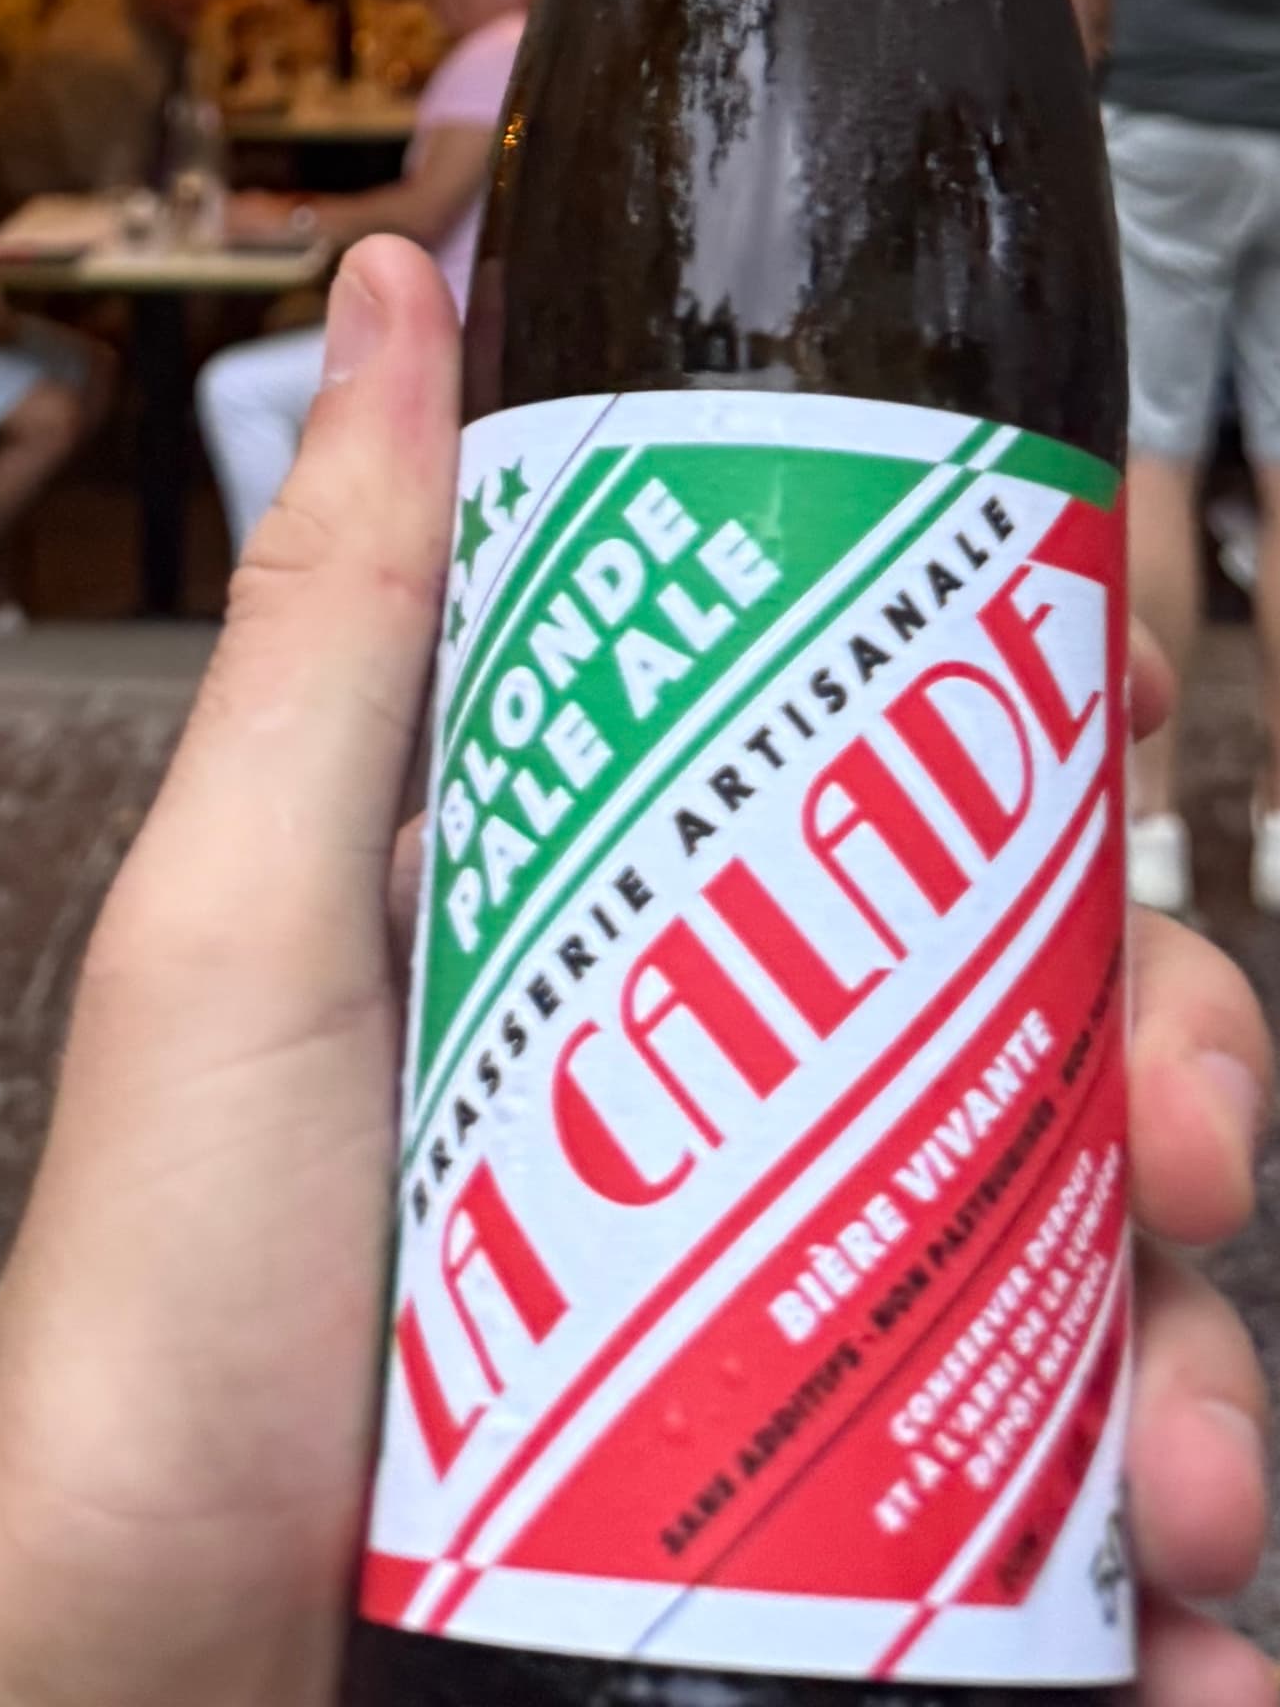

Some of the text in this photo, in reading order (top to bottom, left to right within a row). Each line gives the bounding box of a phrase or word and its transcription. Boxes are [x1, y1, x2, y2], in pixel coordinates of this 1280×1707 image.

[411, 496, 1015, 1226] BRASSERIE ARTISANALE
[438, 477, 701, 862] BLONDE
[446, 518, 783, 954] PALE ALE
[397, 563, 1104, 1483] LA CALADE
[768, 1008, 1052, 1344] BIÈRE VIVANTE
[874, 1480, 920, 1533] ET
[890, 1265, 1031, 1447] CONSERVER
